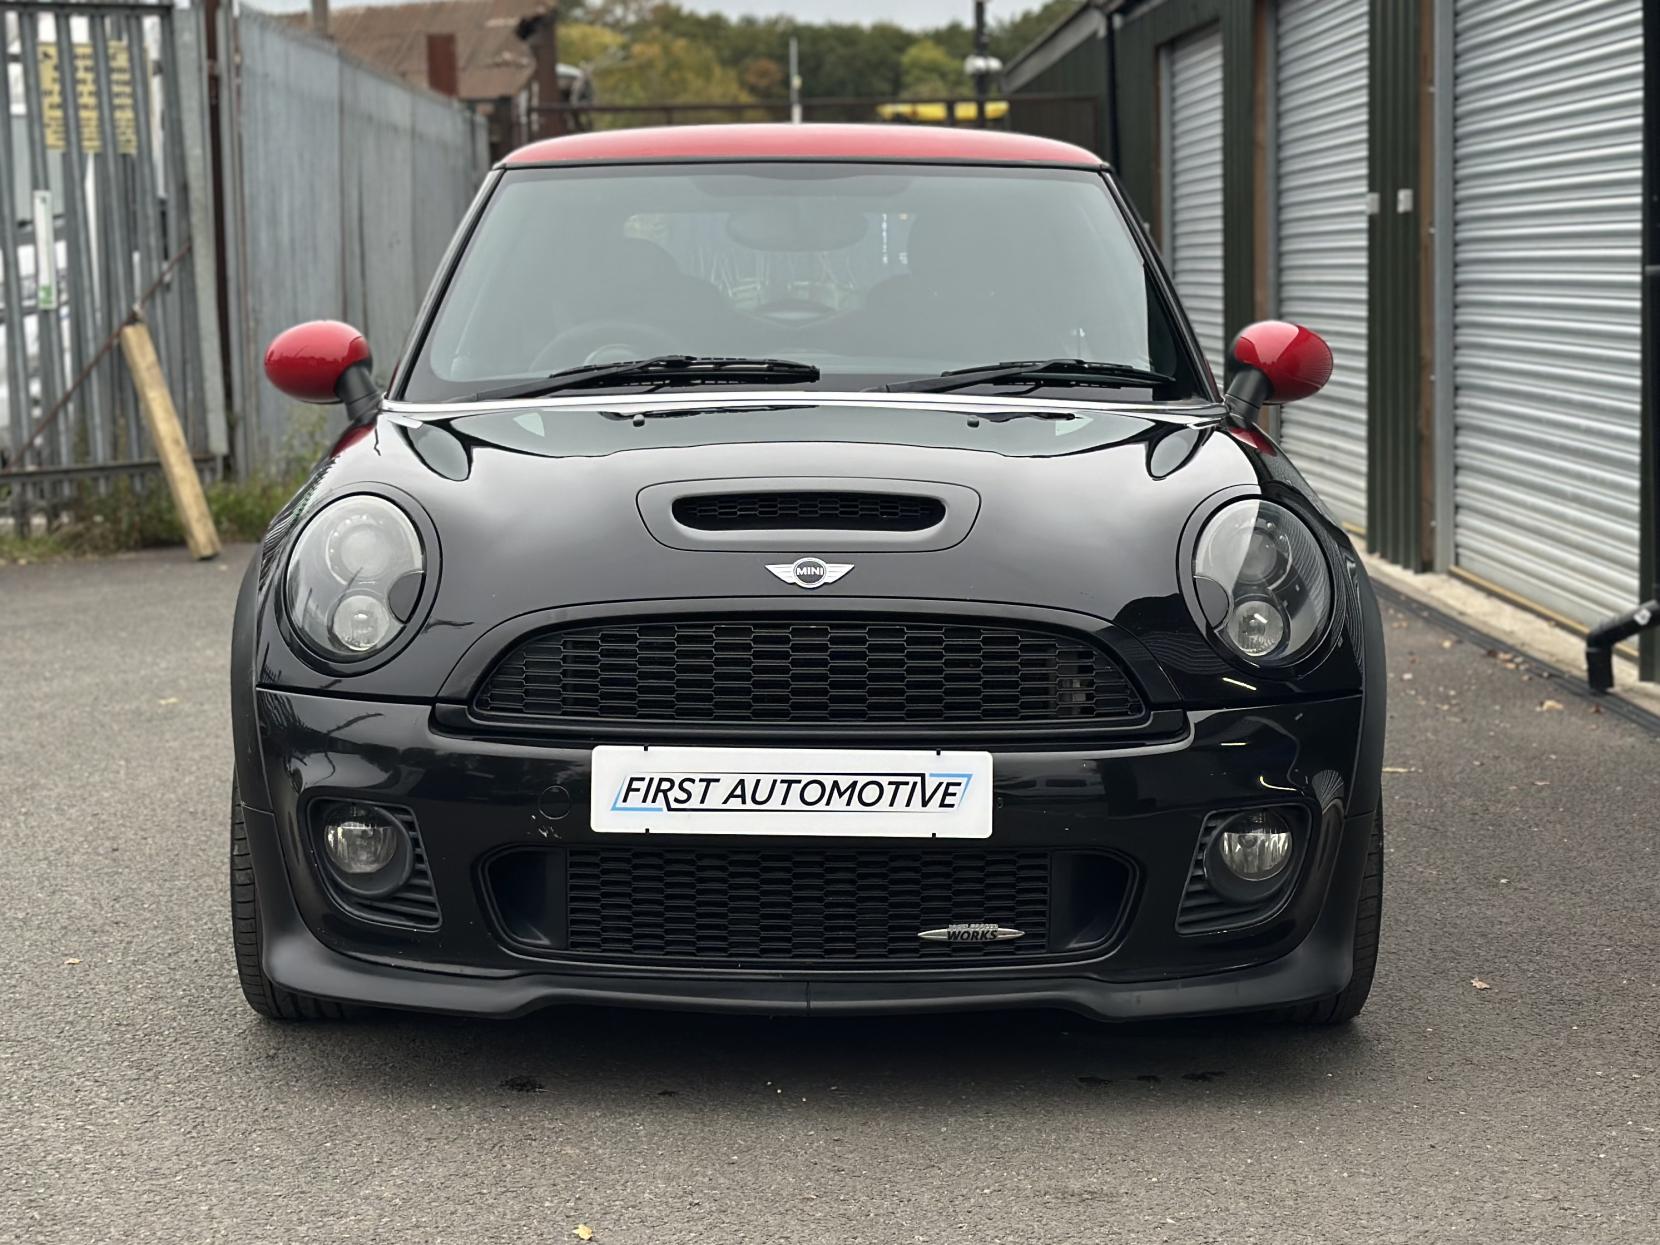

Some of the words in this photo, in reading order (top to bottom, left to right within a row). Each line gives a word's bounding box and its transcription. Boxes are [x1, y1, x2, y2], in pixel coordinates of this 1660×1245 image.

[796, 567, 824, 576] MINI
[621, 775, 720, 810] FIRST
[722, 775, 963, 809] AUTOMOTIVE
[947, 930, 998, 941] WORKS
